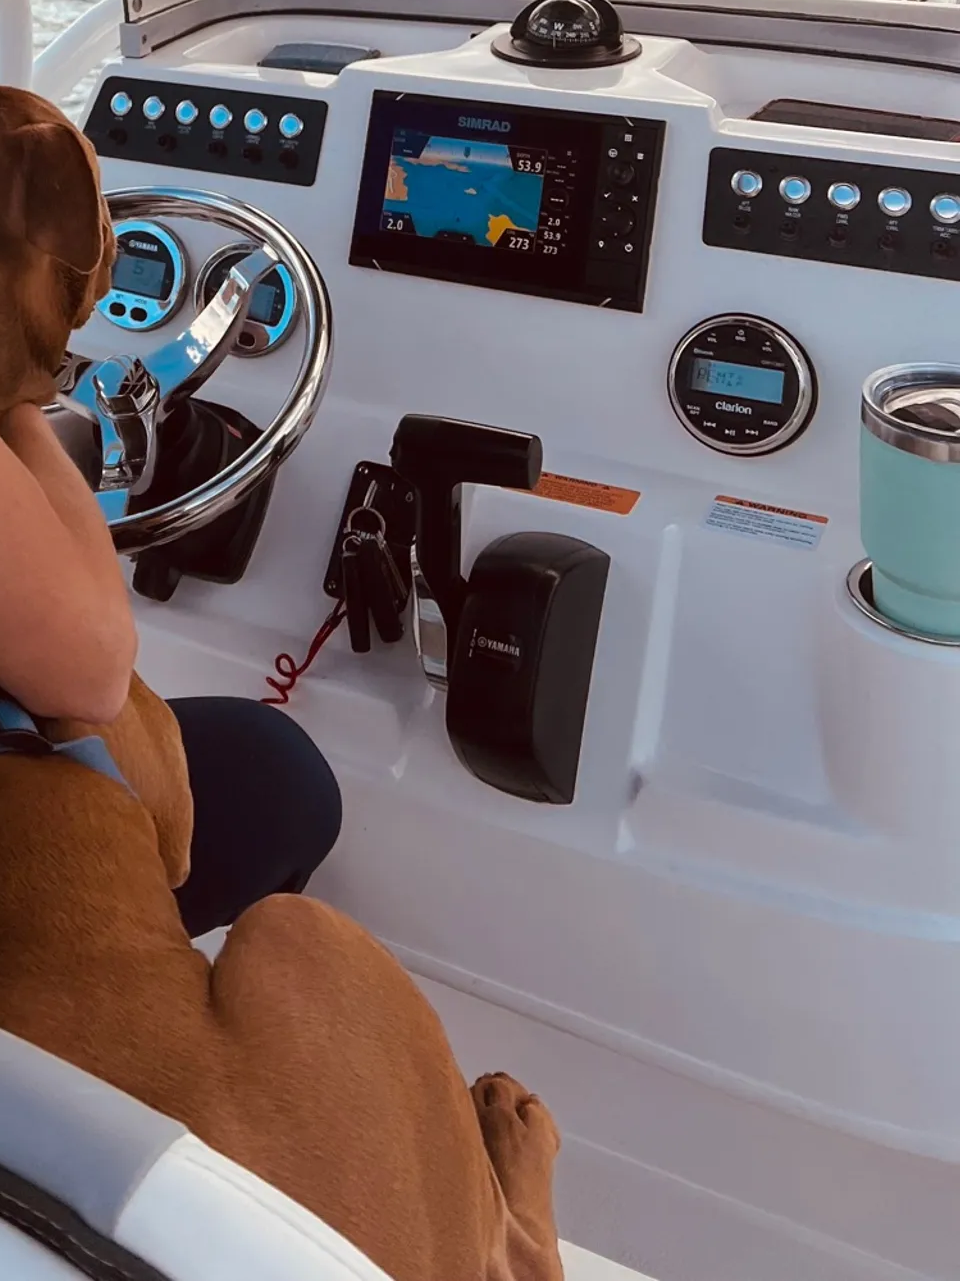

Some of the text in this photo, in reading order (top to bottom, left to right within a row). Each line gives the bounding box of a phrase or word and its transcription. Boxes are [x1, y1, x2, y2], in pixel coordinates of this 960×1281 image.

[554, 22, 564, 30] W
[458, 116, 511, 133] SIMRAD
[517, 159, 542, 173] 53.9
[387, 218, 404, 231] 2.0
[547, 217, 561, 227] 2.0
[543, 230, 561, 241] 53.9
[509, 236, 530, 250] 273
[543, 245, 558, 255] 273
[715, 401, 752, 415] clarion
[748, 501, 808, 519] WARNING
[487, 638, 520, 657] YAMAHA
